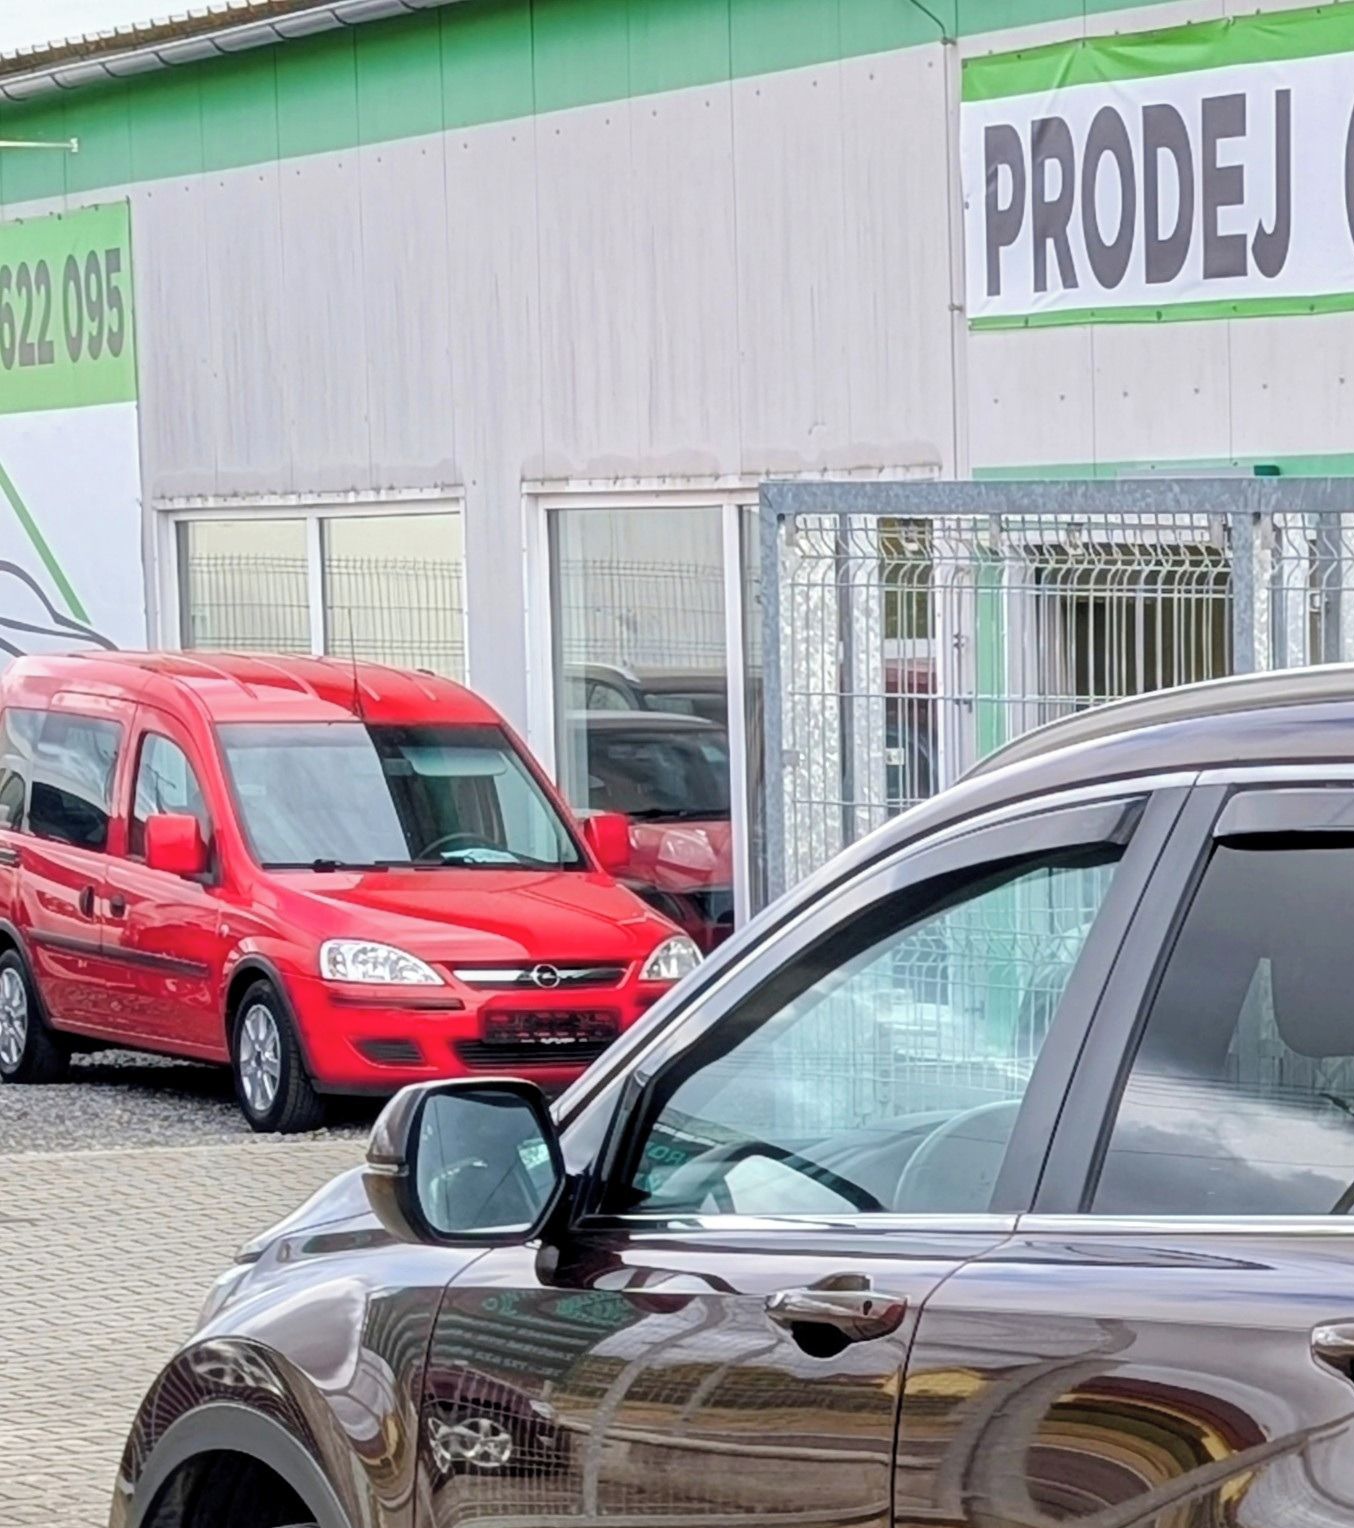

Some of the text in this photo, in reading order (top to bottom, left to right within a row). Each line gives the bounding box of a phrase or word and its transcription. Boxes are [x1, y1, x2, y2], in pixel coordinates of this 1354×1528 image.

[986, 89, 1292, 297] PRODEJ
[0, 247, 125, 370] 622 095
